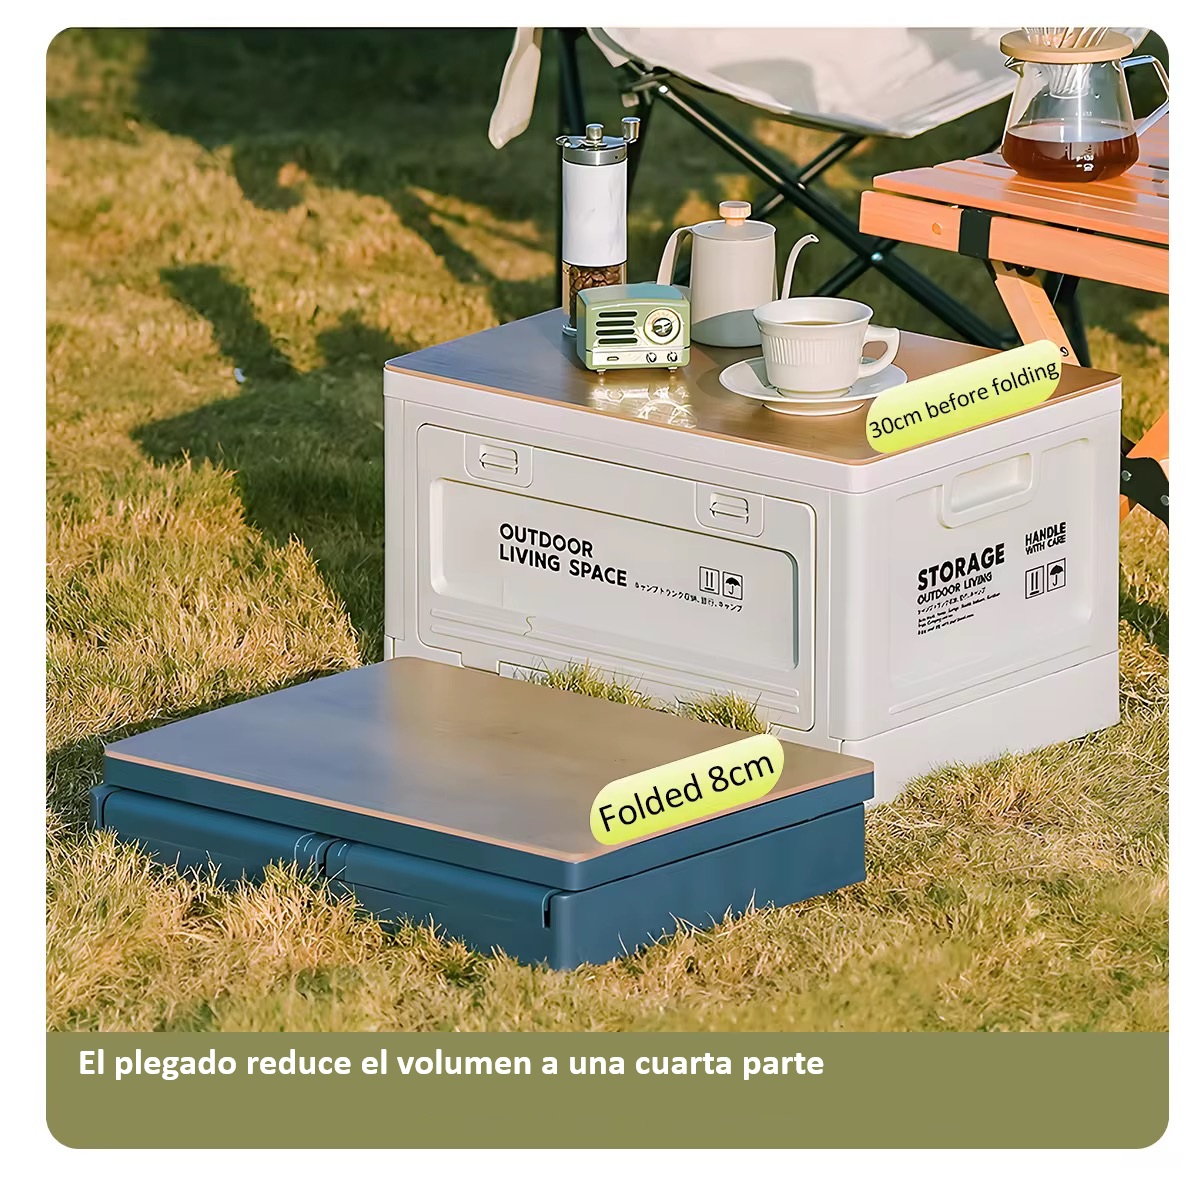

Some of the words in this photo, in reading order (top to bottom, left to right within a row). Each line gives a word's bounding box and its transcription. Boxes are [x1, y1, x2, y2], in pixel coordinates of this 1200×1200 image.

[499, 522, 593, 558] OUTDOOR
[1025, 521, 1067, 547] HANDLE
[1047, 534, 1067, 549] CARE
[499, 543, 562, 572] LIVING
[569, 558, 628, 588] SPACE
[917, 542, 1006, 592] STORAGE
[917, 583, 961, 606] OUTDOOR
